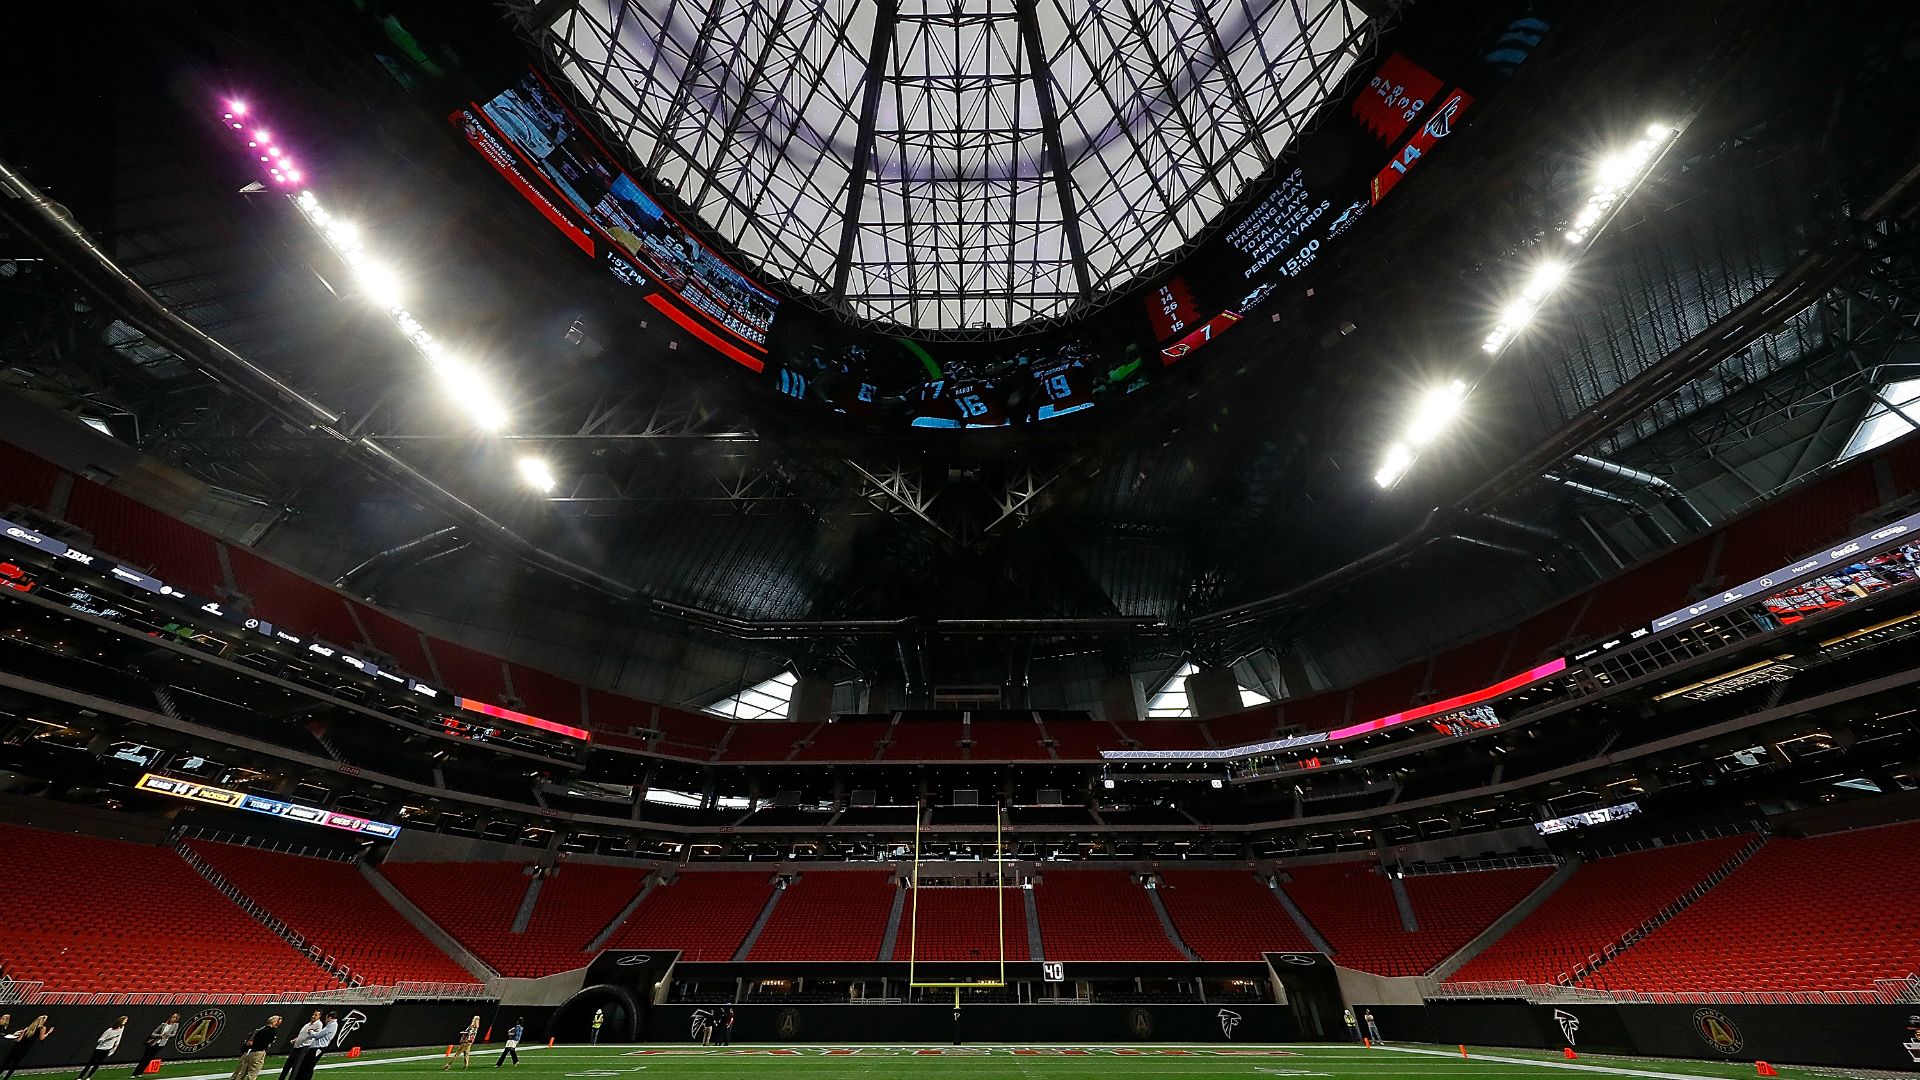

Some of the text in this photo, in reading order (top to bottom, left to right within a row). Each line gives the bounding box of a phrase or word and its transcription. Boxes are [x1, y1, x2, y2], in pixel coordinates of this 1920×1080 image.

[1403, 99, 1425, 122] 30
[1390, 144, 1422, 173] 14
[1225, 167, 1303, 244] RUSHING PLAYS
[1233, 179, 1304, 248] PASSING PLAY
[1241, 226, 1275, 253] TOTAL
[1274, 190, 1309, 225] PLAYS
[1252, 204, 1309, 259] PENALTIES
[1244, 234, 1291, 279] PENALTY
[1291, 199, 1331, 236] YARDS
[606, 251, 629, 272] 1:57
[629, 269, 647, 287] PM
[1278, 239, 1320, 276] 15:00
[1161, 293, 1173, 305] 14
[1163, 301, 1178, 315] 26
[1170, 320, 1184, 333] 15
[1200, 324, 1212, 341] 7
[955, 394, 988, 418] 16
[63, 548, 94, 565] IBM
[1630, 627, 1649, 639] IBM
[198, 790, 231, 802] PACKERS
[1045, 963, 1063, 979] 40
[184, 1019, 212, 1047] A
[1706, 1019, 1735, 1045] A
